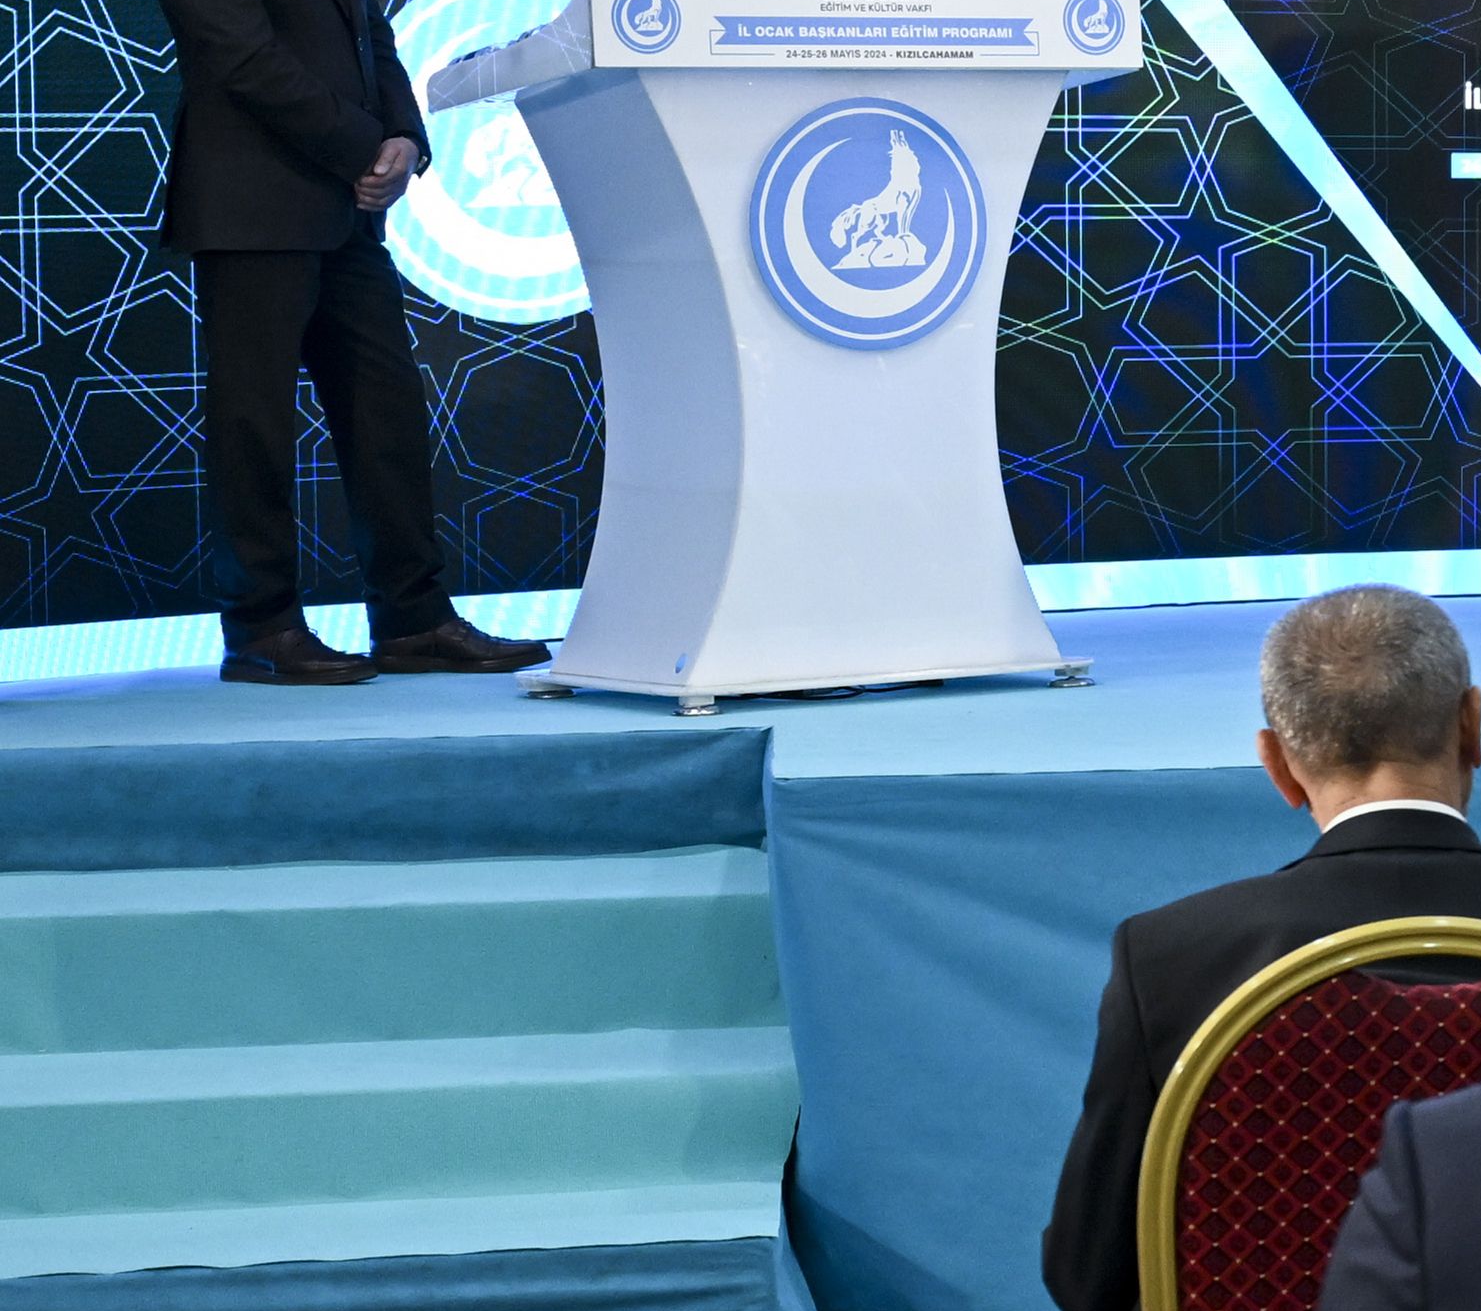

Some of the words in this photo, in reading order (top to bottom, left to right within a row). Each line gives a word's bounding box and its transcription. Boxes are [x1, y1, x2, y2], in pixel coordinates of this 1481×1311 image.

[819, 1, 852, 13] EĞİTİM
[853, 3, 866, 13] VE
[866, 2, 904, 13] KÜLTÜR
[905, 3, 933, 13] VAKFI
[737, 23, 754, 38] İL
[754, 25, 795, 39] OCAK
[798, 25, 888, 40] BAŞKANLARI
[890, 24, 939, 39] EĞİTİM
[941, 26, 1013, 39] PROGRAMI
[785, 49, 828, 60] 24-25-26
[829, 49, 862, 60] MAYIS
[863, 50, 887, 60] 2024
[895, 50, 974, 60] KIZILCAHAMAM
